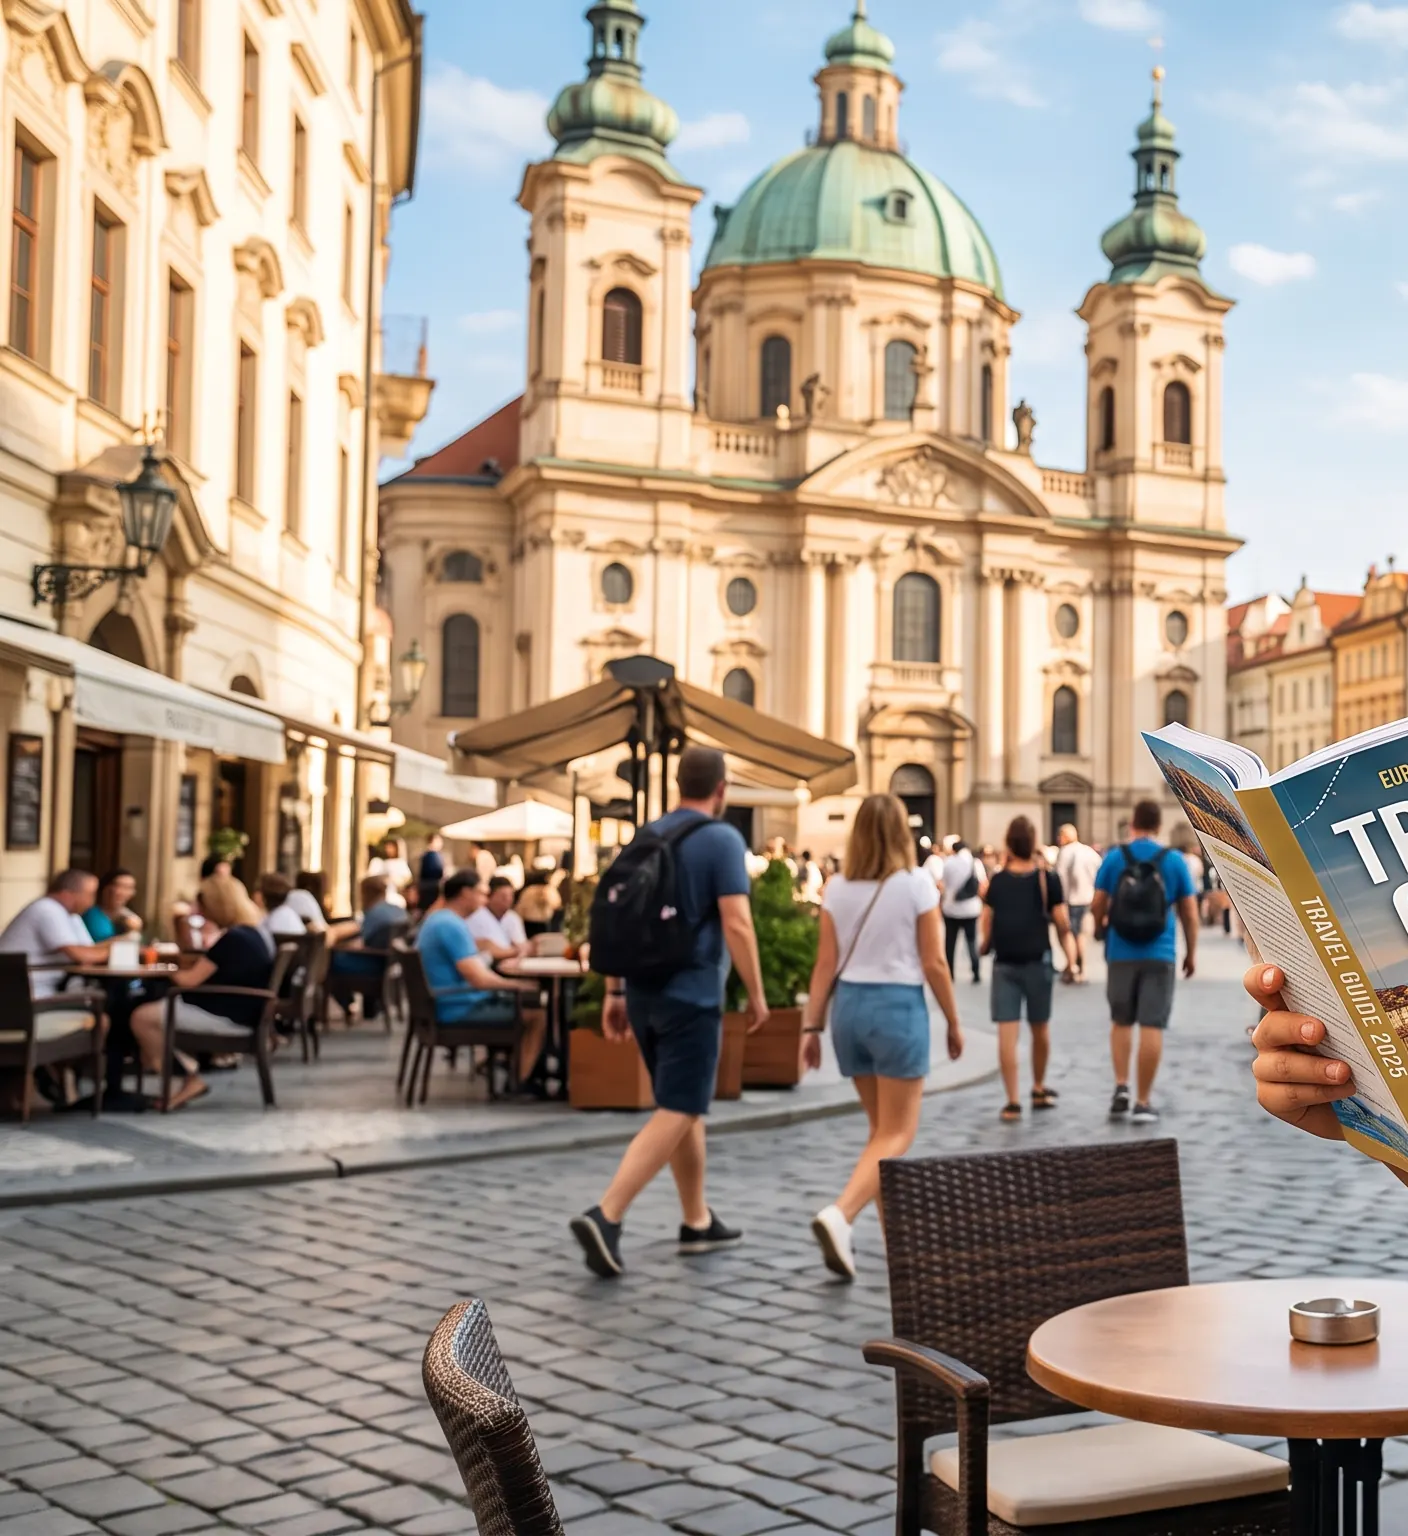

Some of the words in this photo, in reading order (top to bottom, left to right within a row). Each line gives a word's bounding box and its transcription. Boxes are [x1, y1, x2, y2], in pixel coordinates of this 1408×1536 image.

[1300, 895, 1351, 967] TRAVEL
[1339, 971, 1382, 1028] GUIDE
[1370, 1032, 1408, 1079] 2025
